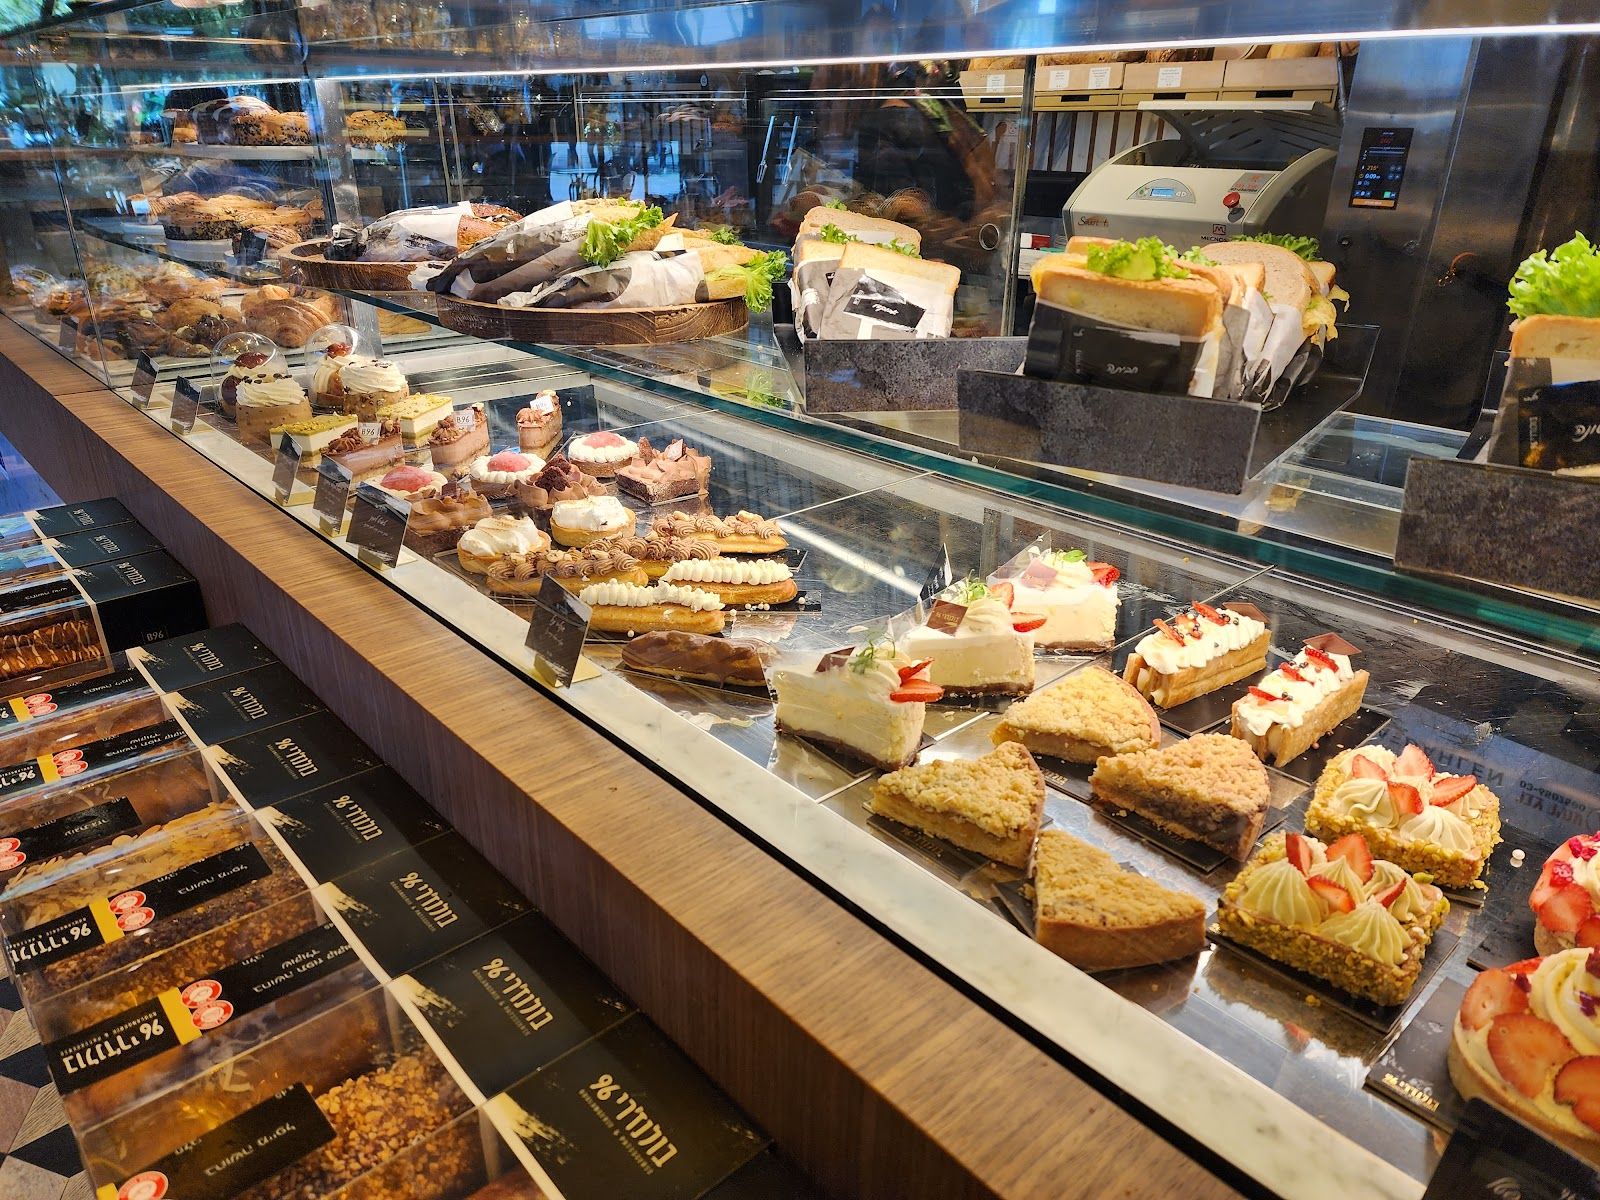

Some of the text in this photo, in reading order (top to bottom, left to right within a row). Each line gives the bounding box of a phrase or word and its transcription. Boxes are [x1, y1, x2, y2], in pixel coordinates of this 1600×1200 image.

[361, 427, 375, 436] B96
[146, 631, 164, 642] B96
[68, 921, 92, 941] 96
[324, 941, 352, 960] קוקו
[140, 1019, 164, 1040] 96
